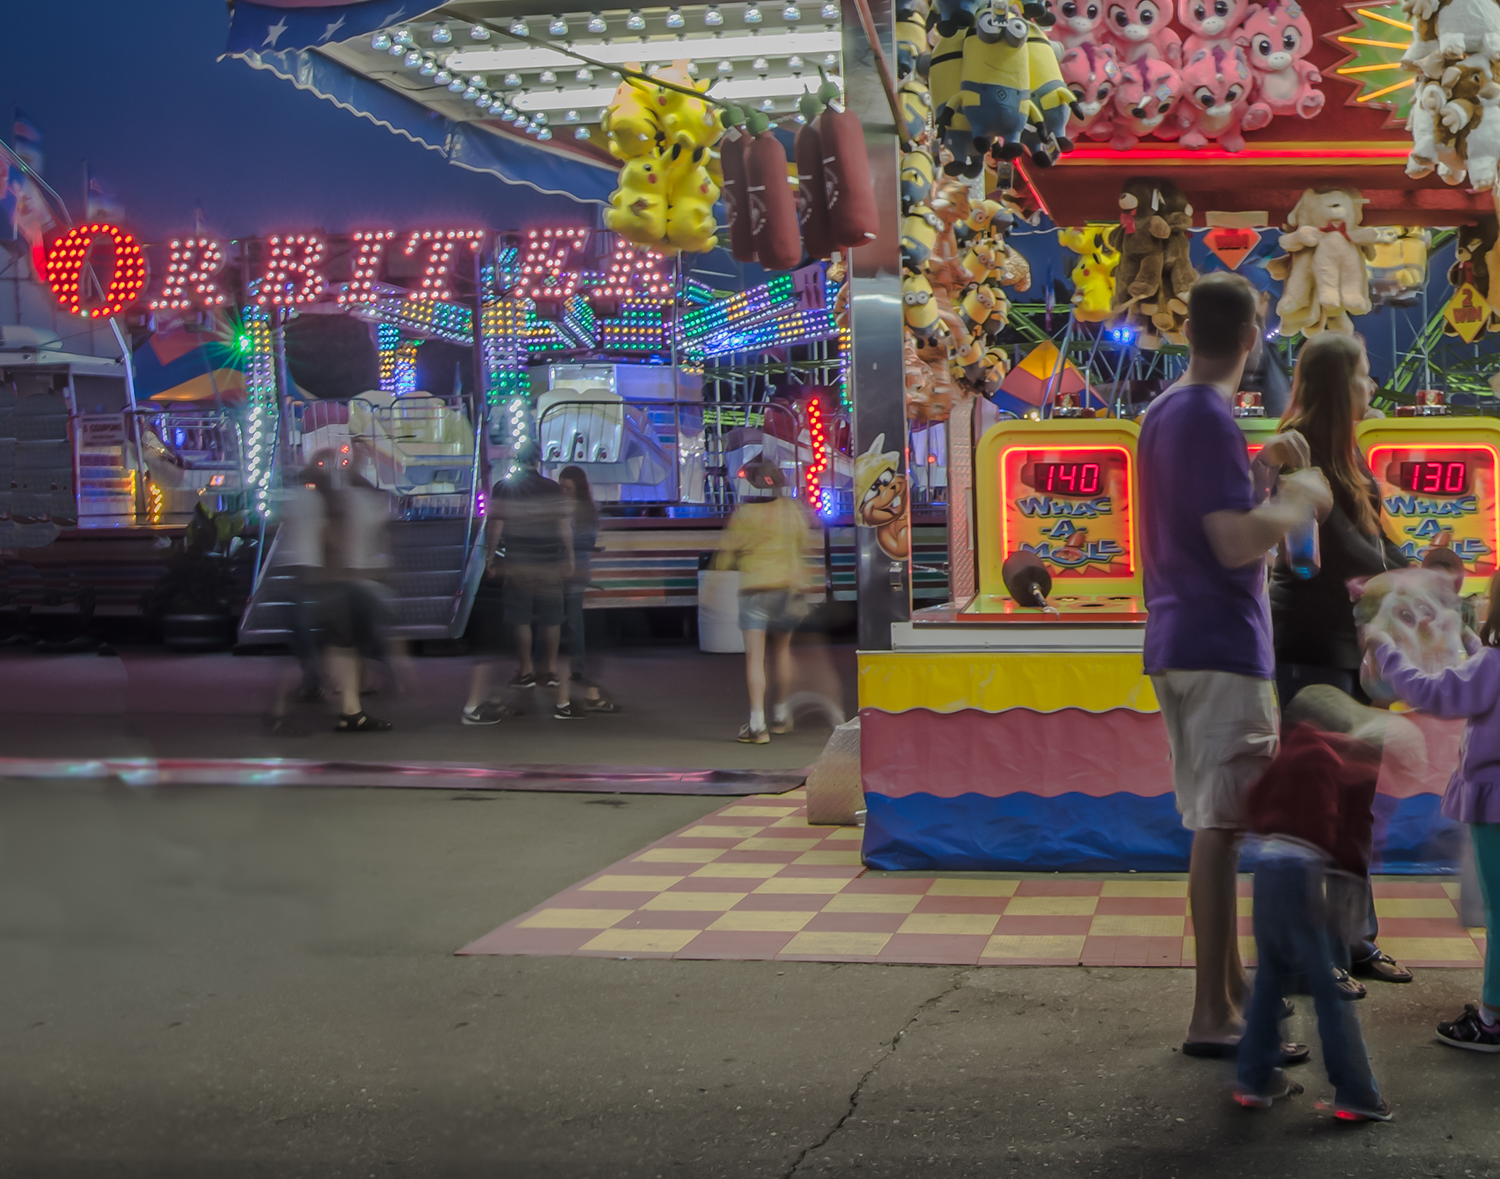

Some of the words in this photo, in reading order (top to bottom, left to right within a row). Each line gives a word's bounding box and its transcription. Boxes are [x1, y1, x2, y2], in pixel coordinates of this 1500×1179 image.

[46, 222, 674, 318] ORBITER
[1462, 287, 1474, 308] 2
[1453, 305, 1482, 324] WIN
[1046, 463, 1100, 493] 140
[1411, 462, 1466, 492] 130
[1017, 496, 1112, 518] WHAC
[1383, 494, 1478, 515] WHAC
